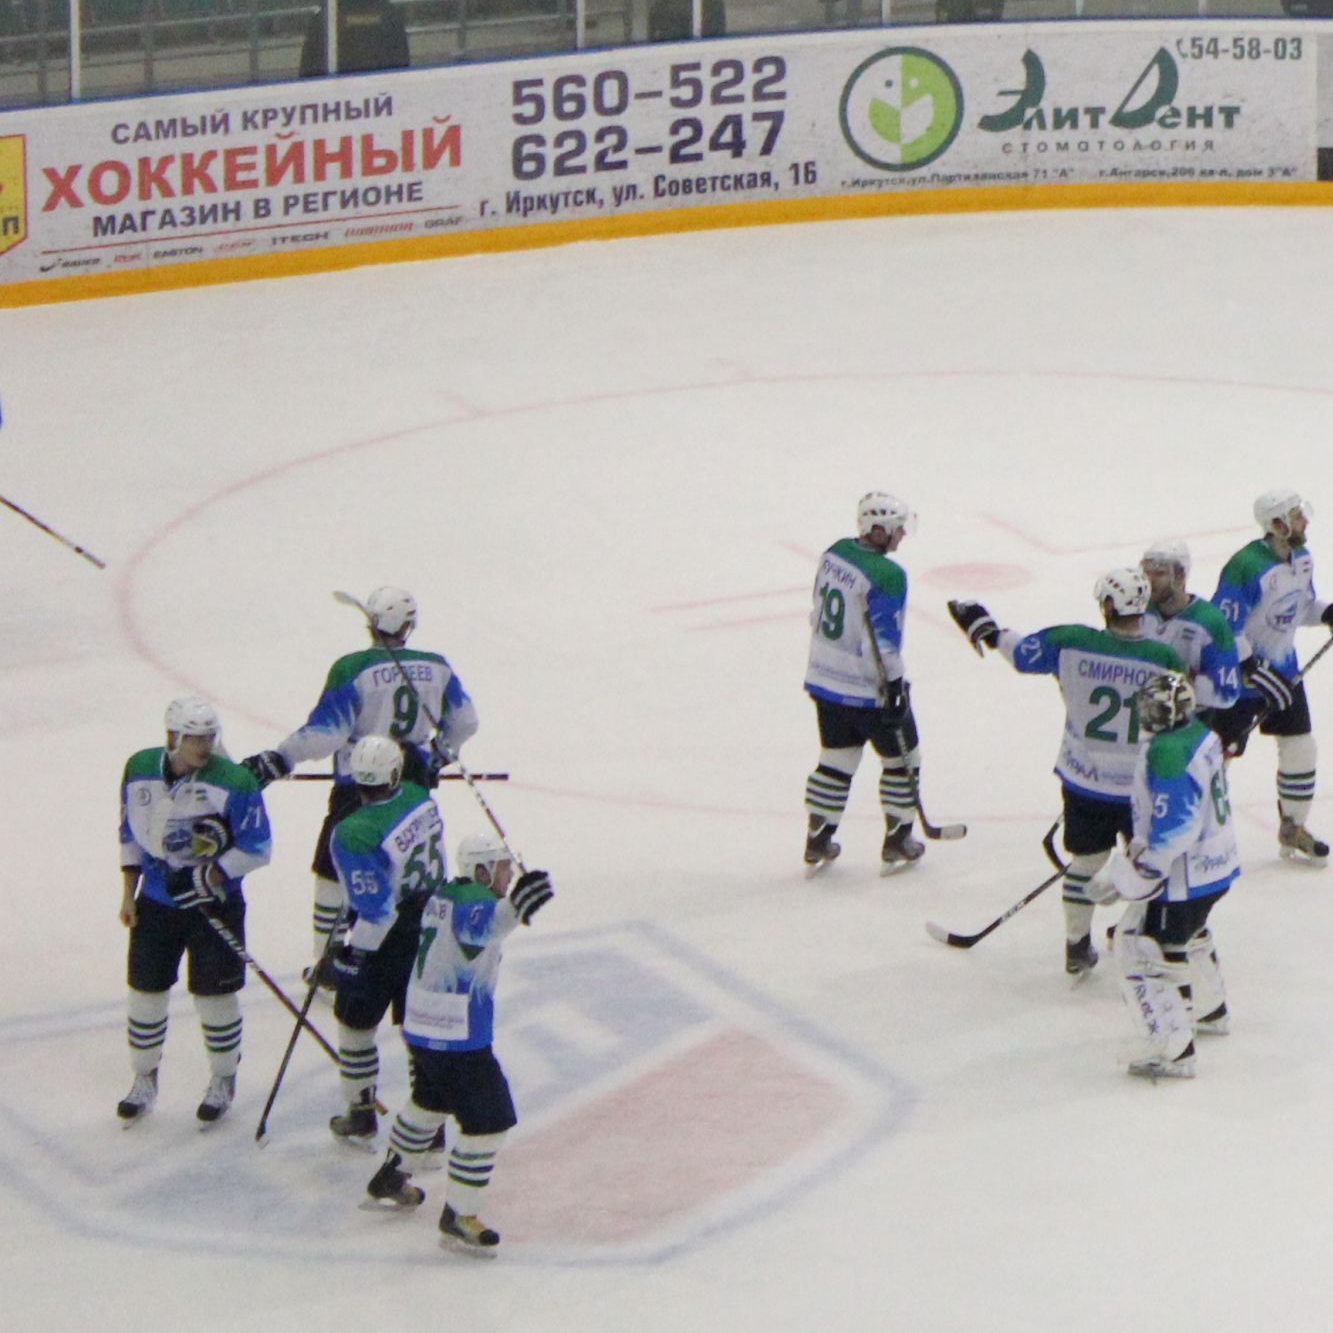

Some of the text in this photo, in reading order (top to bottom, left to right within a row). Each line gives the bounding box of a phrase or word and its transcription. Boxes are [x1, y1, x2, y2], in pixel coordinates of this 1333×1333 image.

[1190, 36, 1303, 62] 54-58-03
[511, 55, 787, 126] 560-522
[111, 92, 394, 145] САМЫЙ КРУПНЫЙ
[511, 110, 786, 181] 622-247
[41, 114, 462, 213] ХОККЕЙНЫЙ
[92, 181, 425, 238] МАГАЗИН В РЕГИОНЕ
[505, 186, 605, 218] Иркутск,
[613, 182, 645, 207] ул.
[653, 170, 779, 199] Советская,
[818, 582, 846, 642] 19
[1218, 666, 1240, 689] 14
[389, 684, 419, 738] 9
[1084, 685, 1141, 745] 21
[351, 870, 379, 895] 55
